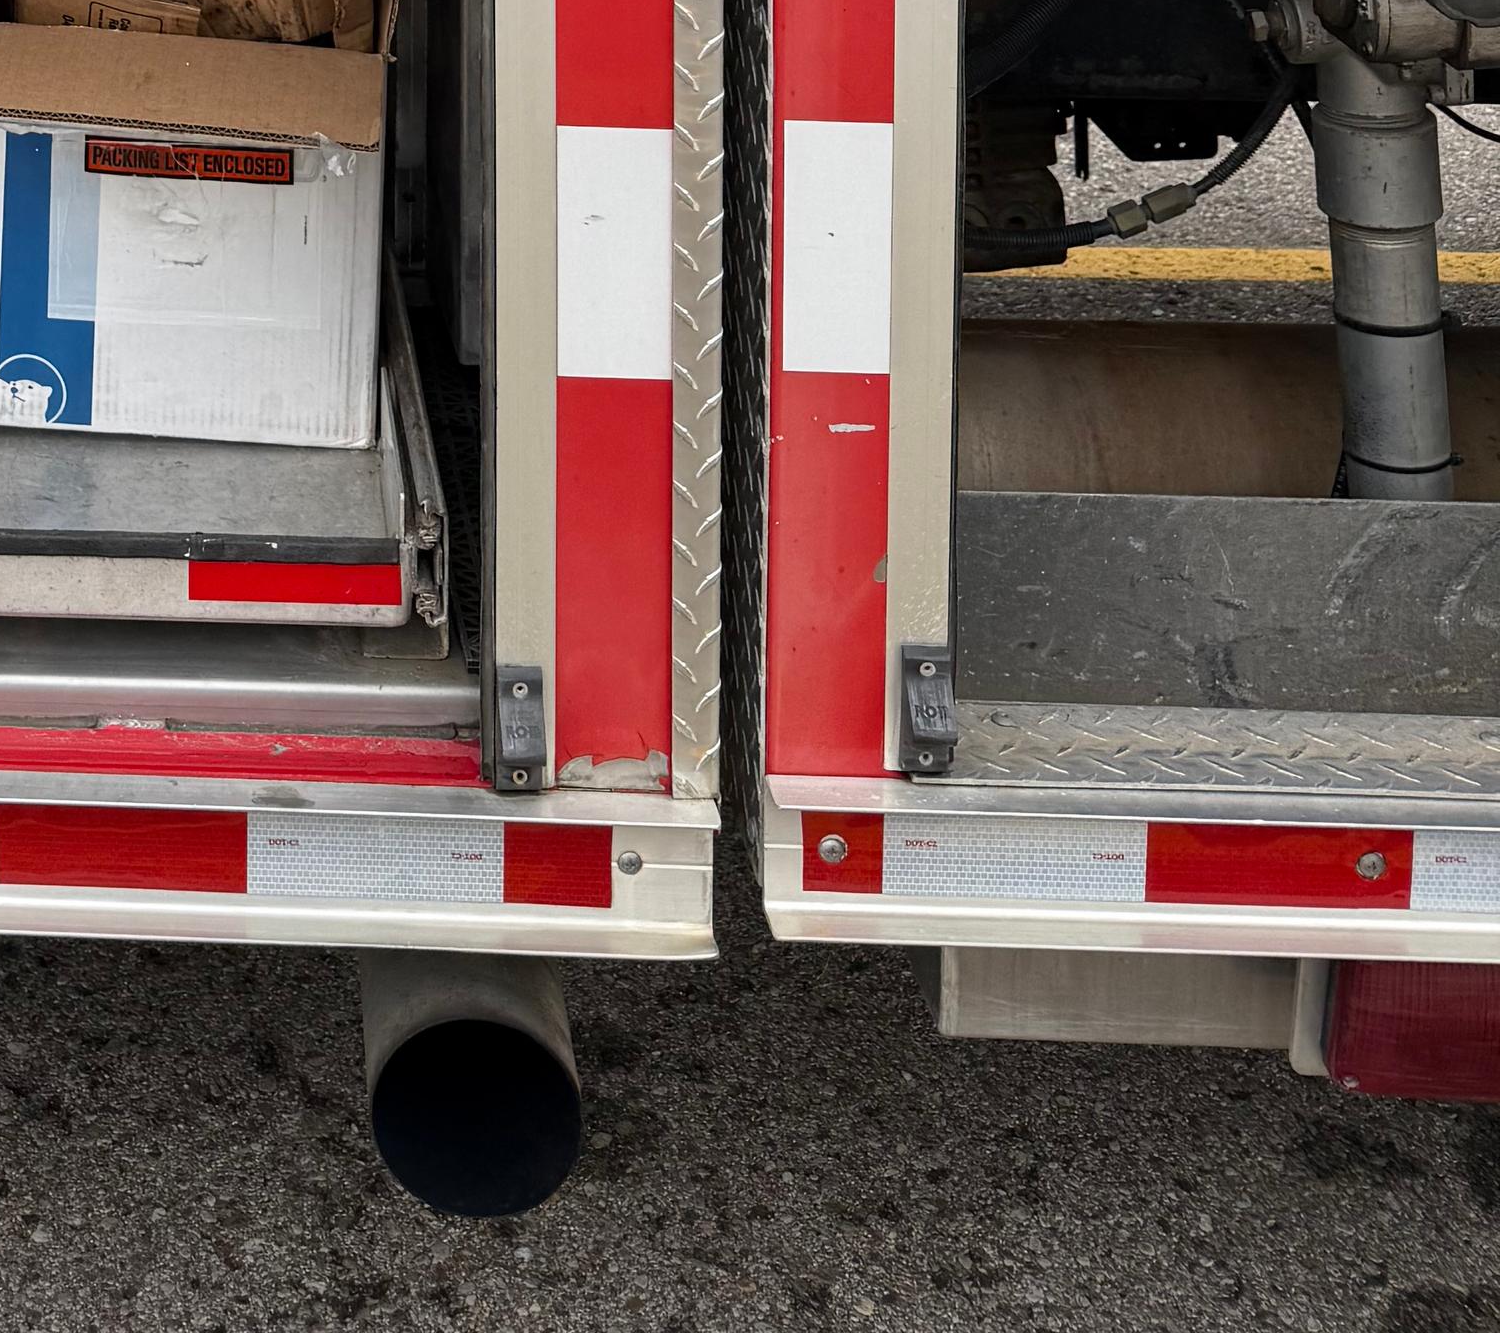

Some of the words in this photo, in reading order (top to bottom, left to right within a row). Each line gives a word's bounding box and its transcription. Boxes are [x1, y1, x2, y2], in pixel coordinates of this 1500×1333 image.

[92, 145, 160, 169] PACKING
[164, 151, 199, 172] LIST
[203, 154, 286, 177] ENCLOSED
[905, 839, 938, 848] DOT-C2
[1092, 852, 1125, 861] DOT-C2
[1435, 855, 1467, 863] DOT-C2
